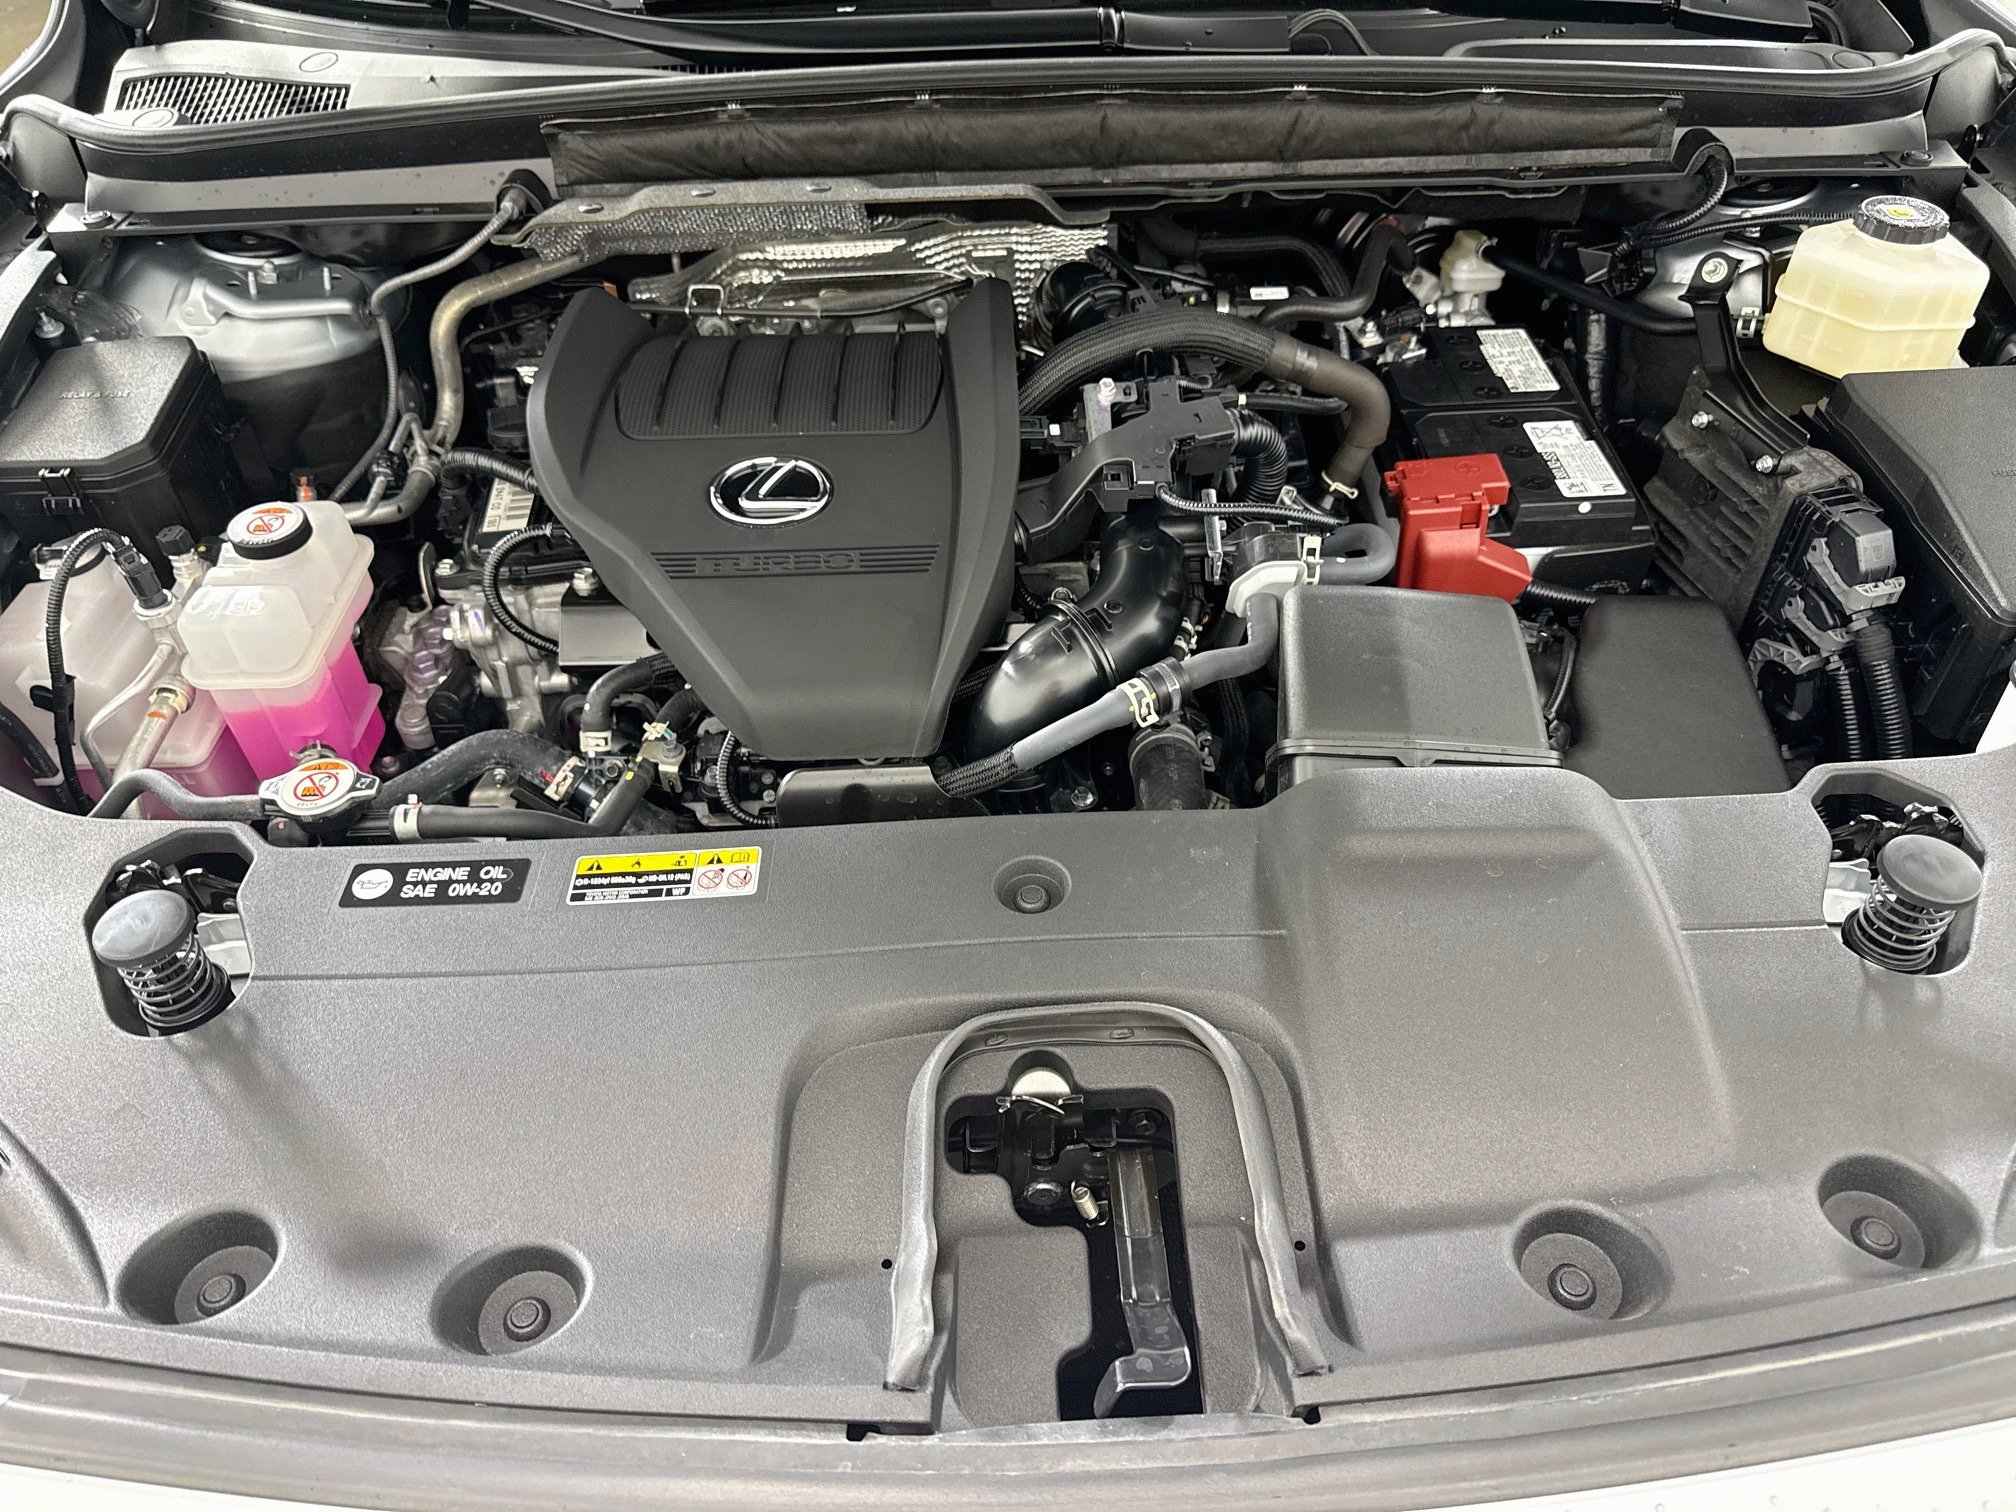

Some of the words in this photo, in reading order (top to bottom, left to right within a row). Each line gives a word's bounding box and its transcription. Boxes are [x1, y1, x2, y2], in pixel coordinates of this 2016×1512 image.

[701, 552, 855, 573] TURBO
[405, 866, 471, 882] ENGINE
[479, 865, 508, 880] OIL
[399, 884, 438, 898] SAE
[447, 881, 503, 897] 0W-20
[671, 887, 686, 896] WF
